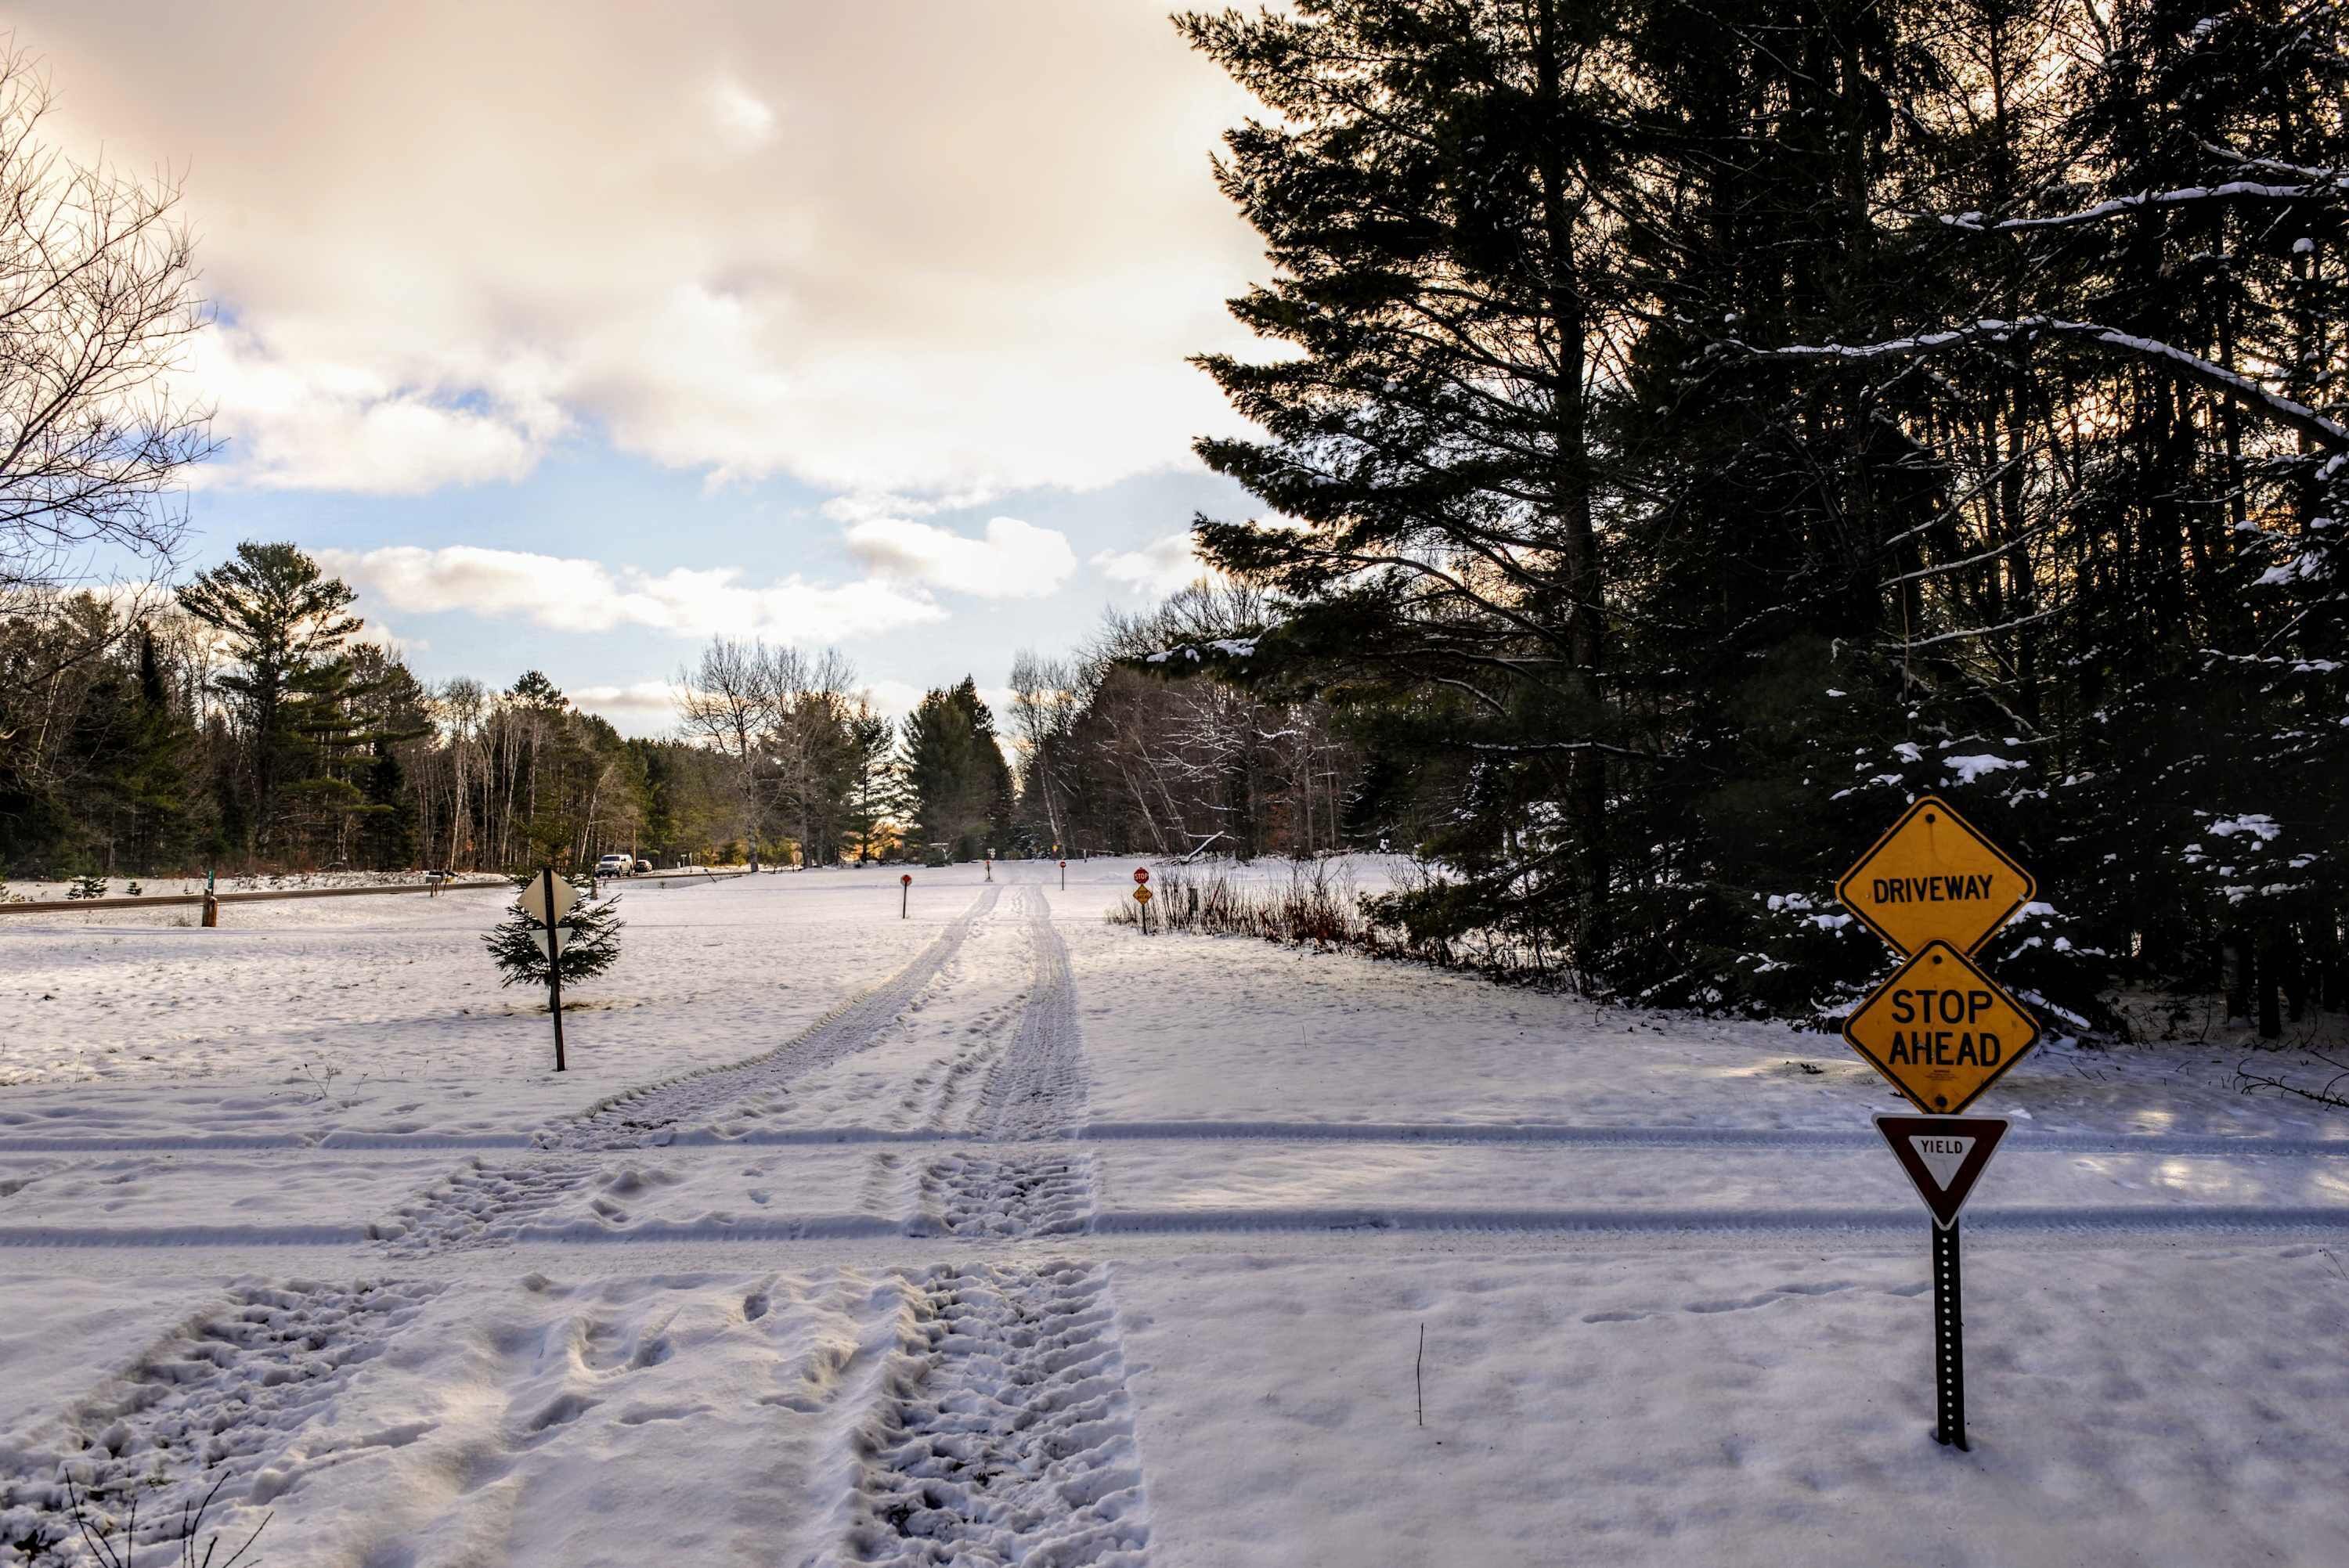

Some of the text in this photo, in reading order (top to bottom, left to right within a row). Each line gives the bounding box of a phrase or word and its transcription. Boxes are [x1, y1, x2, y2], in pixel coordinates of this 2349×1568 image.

[1873, 874, 1993, 904] DRIVEWAY
[1892, 989, 1993, 1024] STOP
[1889, 1032, 2001, 1066] AHEAD
[1921, 1140, 1963, 1155] YIELD
